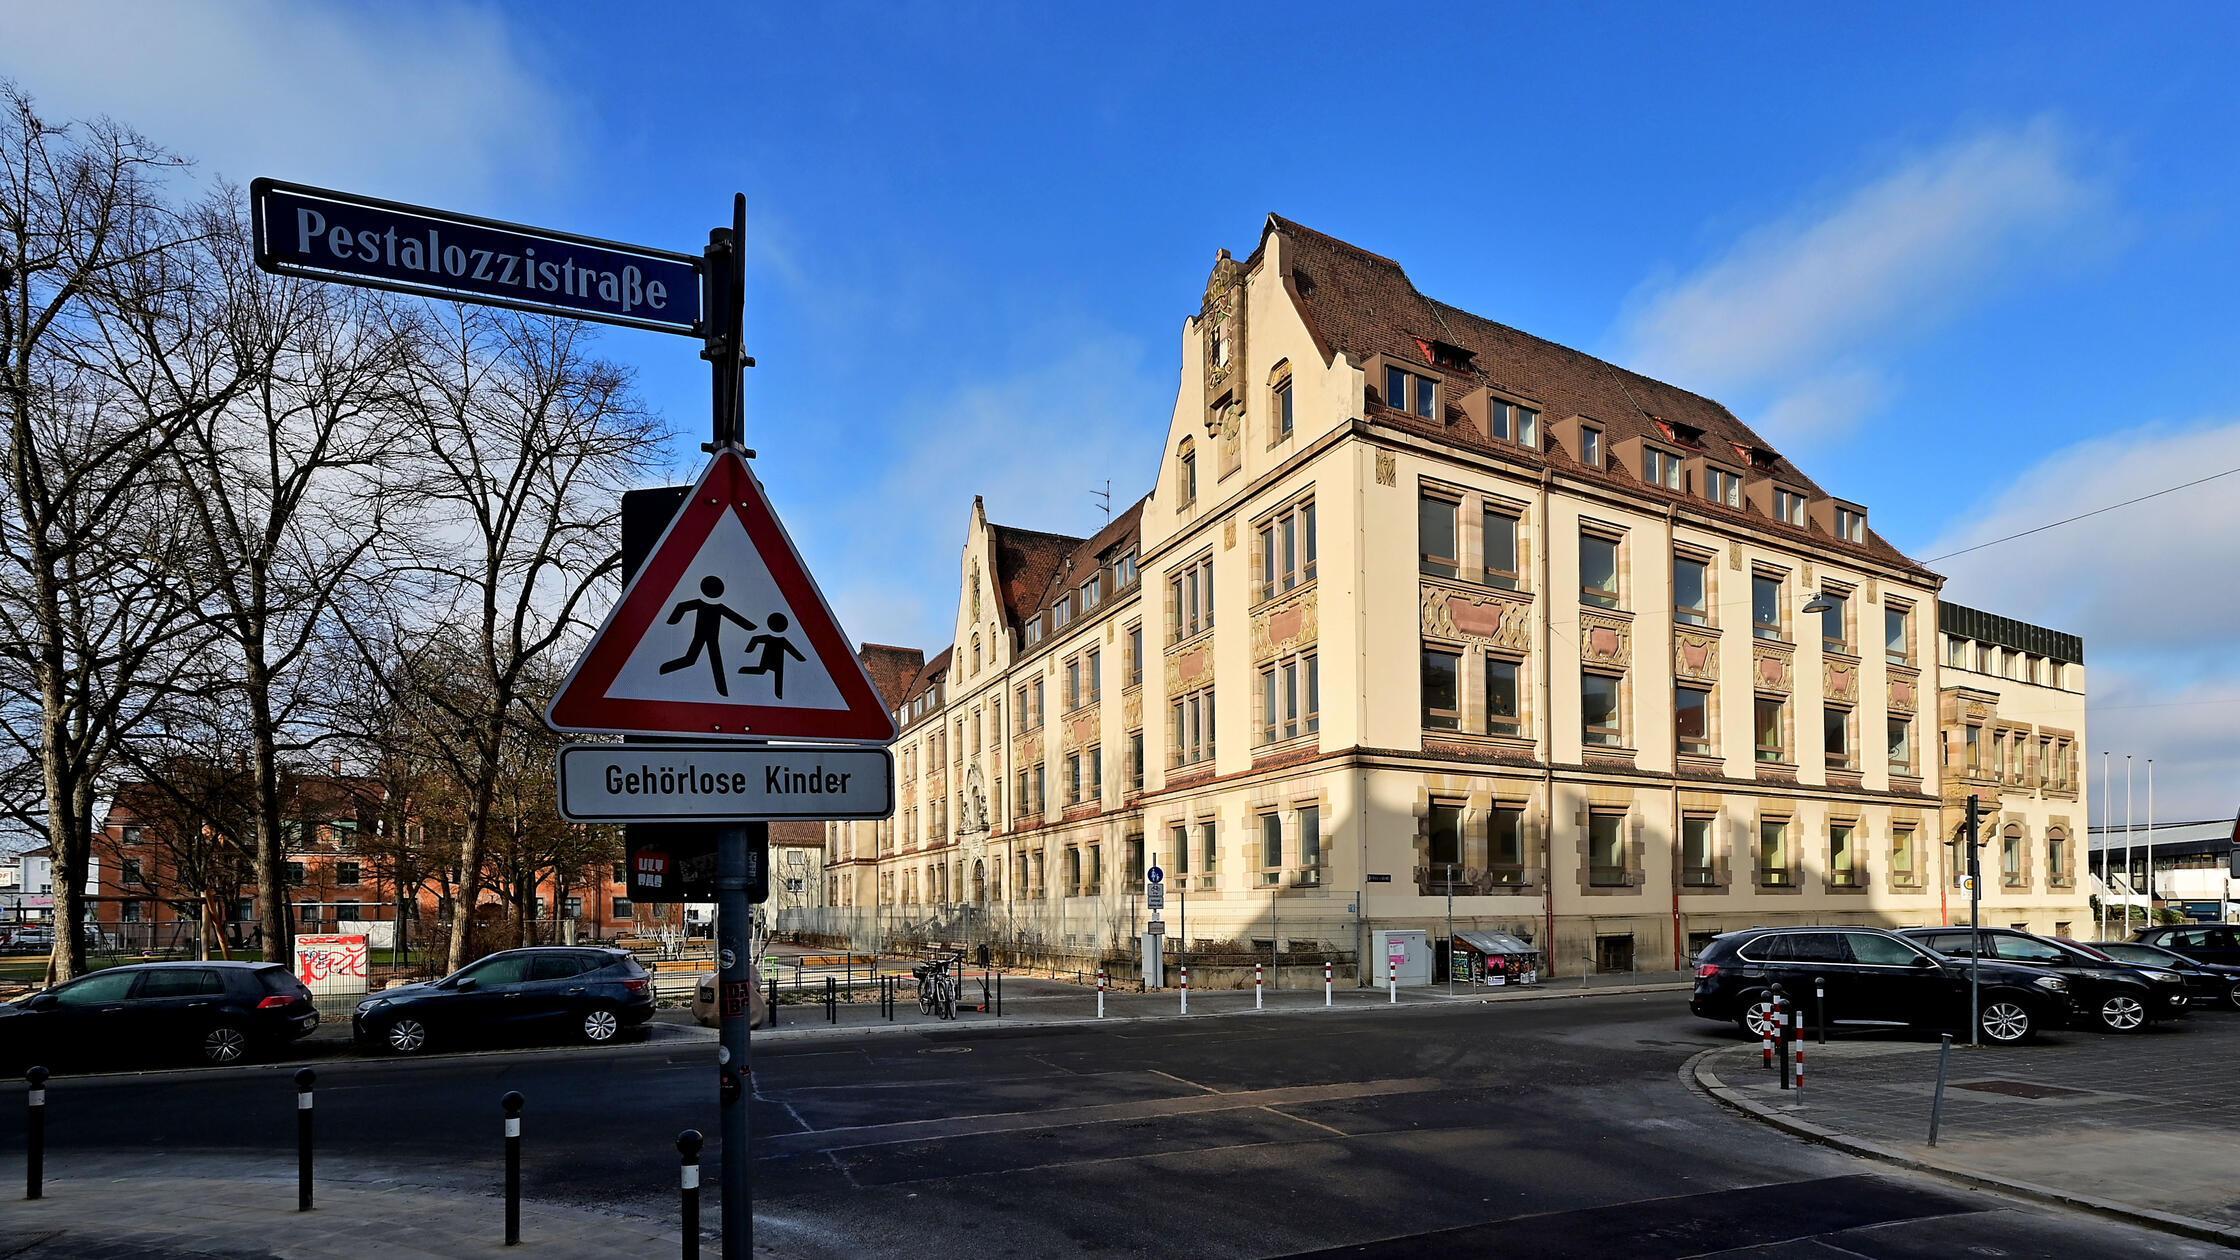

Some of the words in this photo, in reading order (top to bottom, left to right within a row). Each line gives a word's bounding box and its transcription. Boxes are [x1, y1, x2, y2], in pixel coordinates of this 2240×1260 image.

[297, 207, 668, 312] Pestalozzistraße
[605, 764, 746, 794] Gehörlose
[765, 765, 851, 794] Kinder
